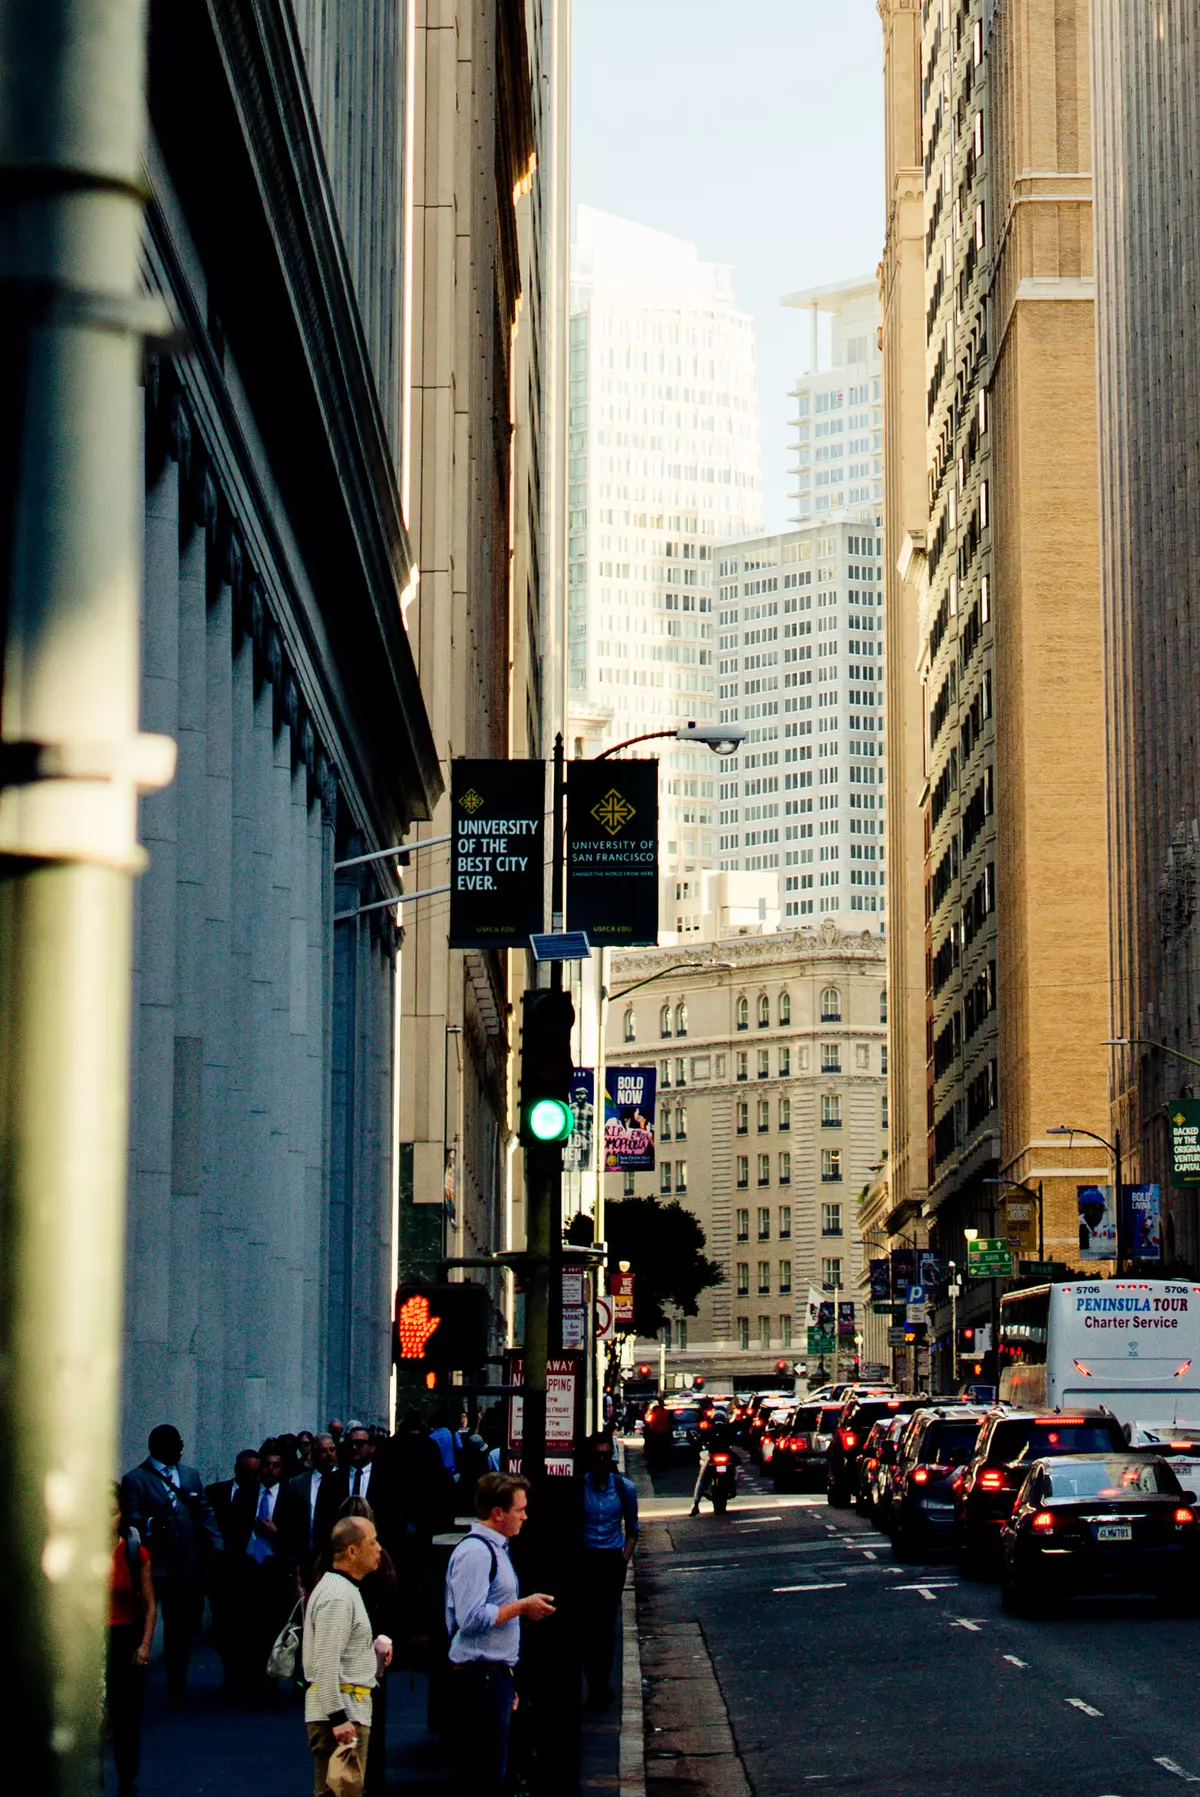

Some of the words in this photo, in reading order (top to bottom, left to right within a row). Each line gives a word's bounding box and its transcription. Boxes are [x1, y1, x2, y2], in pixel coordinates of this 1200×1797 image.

[458, 820, 538, 835] UNIVERSITY
[457, 838, 476, 853] OF
[481, 838, 508, 853] THE
[572, 841, 636, 850] UNIVERSITY
[640, 840, 654, 849] OF
[572, 853, 593, 862] SAN
[596, 852, 654, 862] FRANCISCO
[457, 857, 492, 871] BEST
[496, 857, 528, 871] CITY
[457, 876, 497, 890] EVER.
[617, 1076, 644, 1090] BOLD
[617, 1089, 643, 1104] NOW
[1173, 1126, 1199, 1136] BACKED
[1174, 1136, 1183, 1145] BY
[1184, 1136, 1197, 1144] THE
[1131, 1192, 1150, 1202] BOLD
[1076, 1286, 1100, 1294] 5706
[1164, 1286, 1189, 1294] 5706
[1076, 1298, 1151, 1312] PENINSULA
[1153, 1298, 1188, 1312] TOUR
[1084, 1316, 1130, 1328] Charter
[1133, 1316, 1178, 1328] Service
[548, 1378, 572, 1392] PPING
